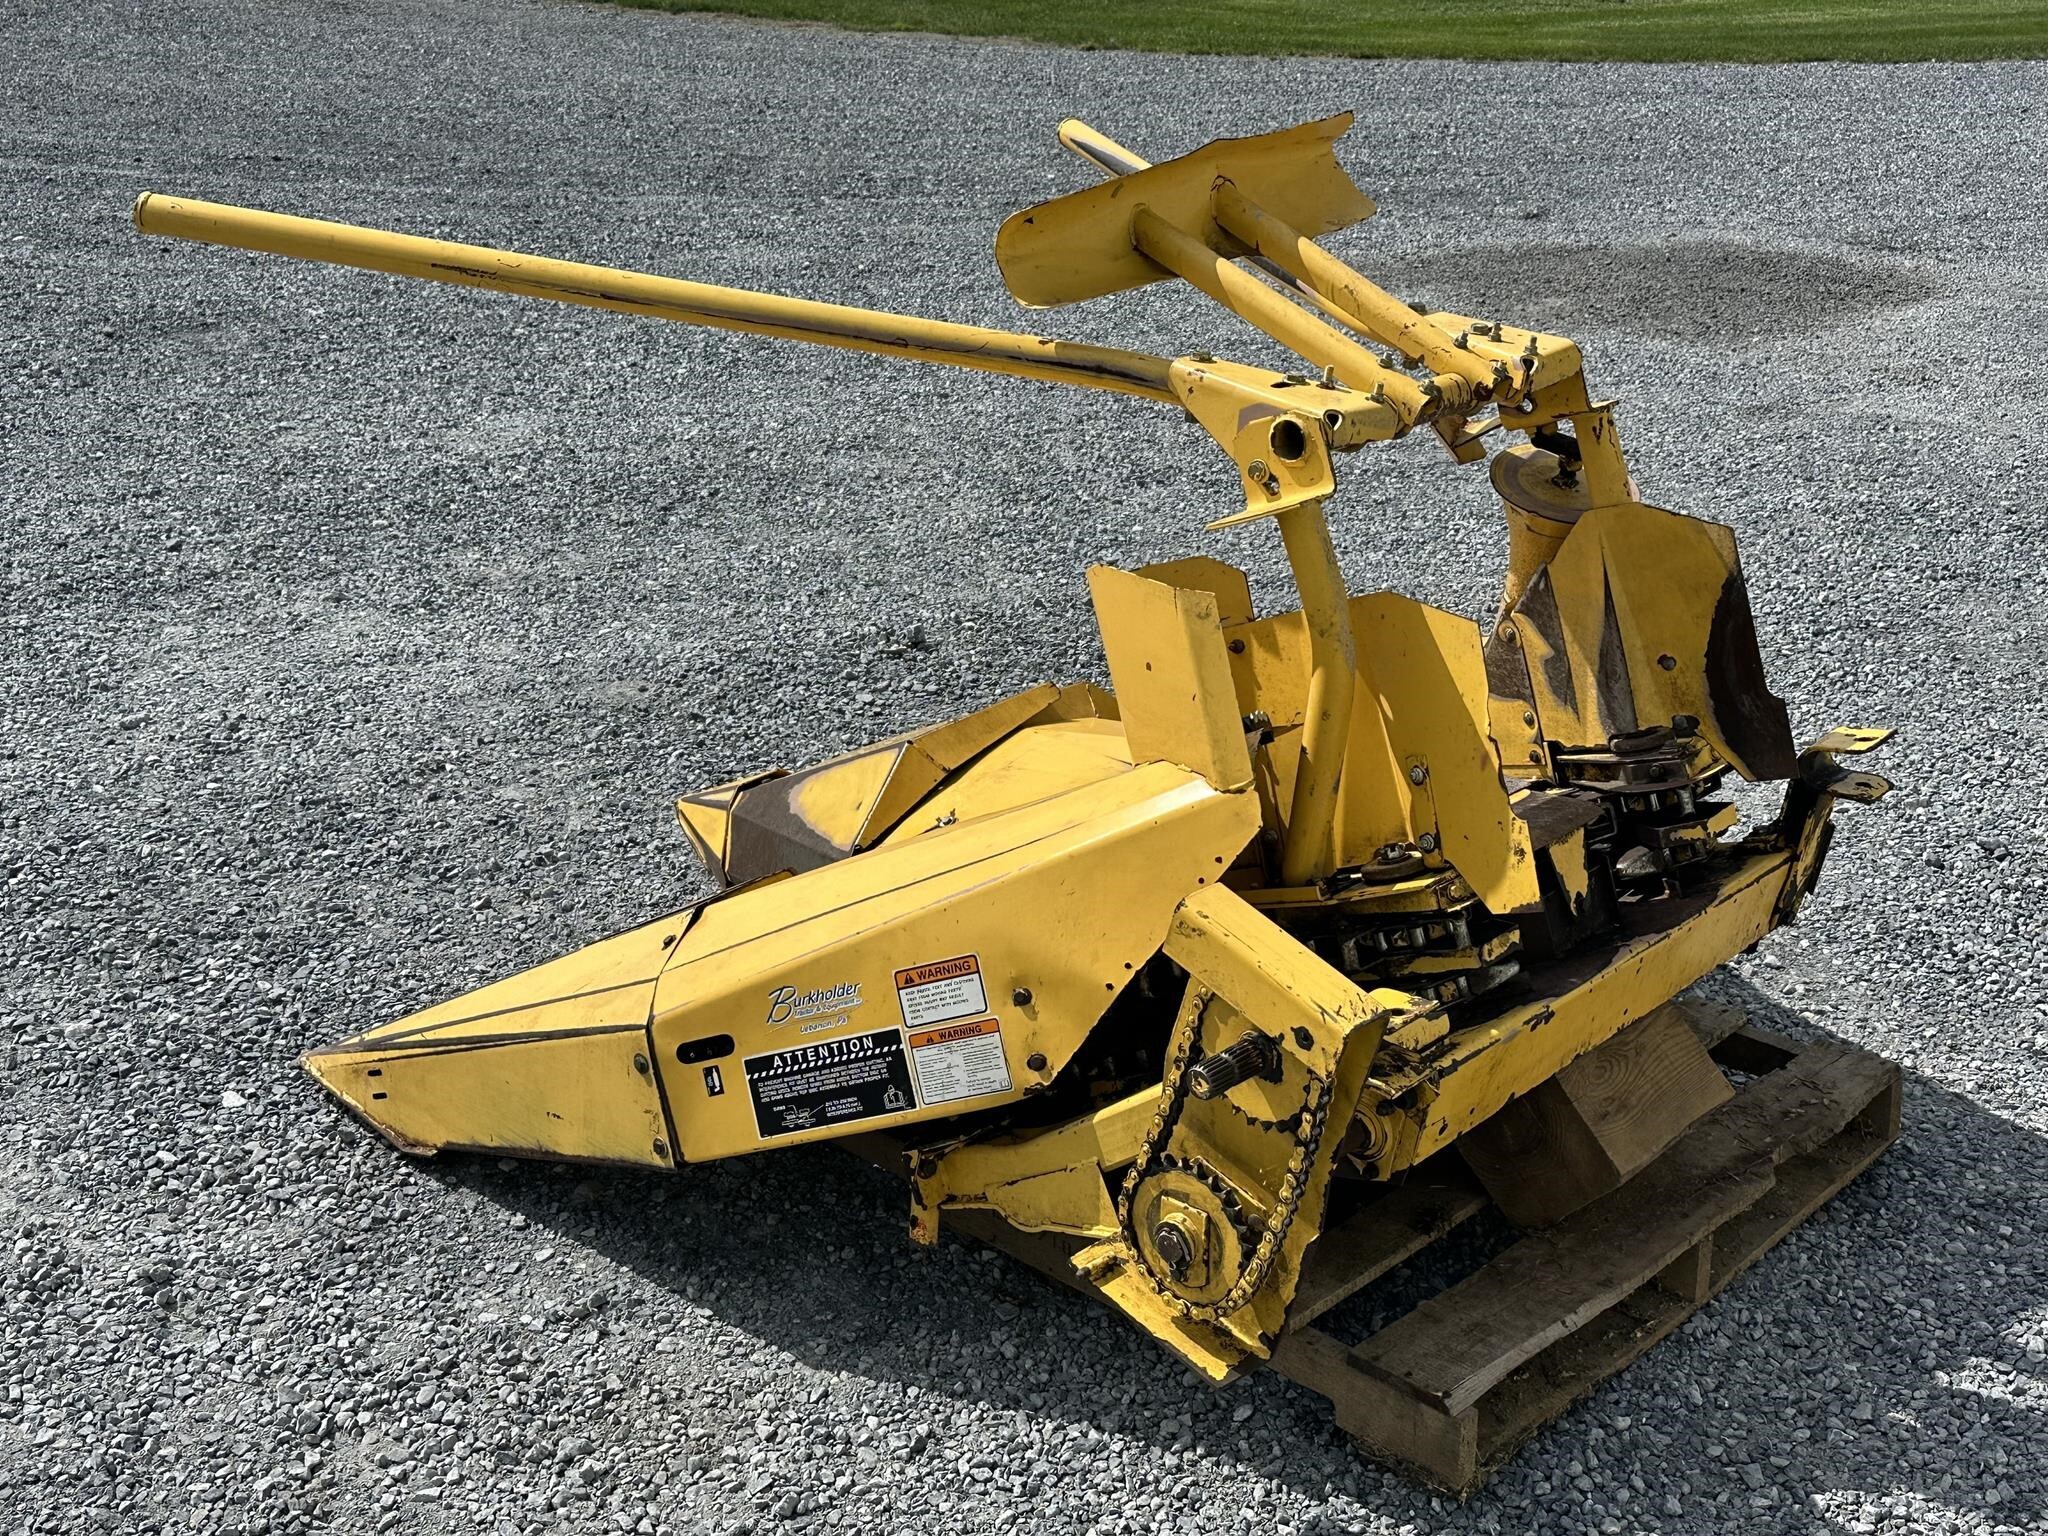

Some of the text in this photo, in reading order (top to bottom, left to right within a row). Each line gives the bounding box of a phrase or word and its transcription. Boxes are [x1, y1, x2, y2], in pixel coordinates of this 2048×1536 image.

[916, 960, 971, 981] WARNING
[766, 982, 862, 1024] Burkholder
[938, 1025, 982, 1040] WARNING
[773, 1036, 874, 1068] ATTENTION
